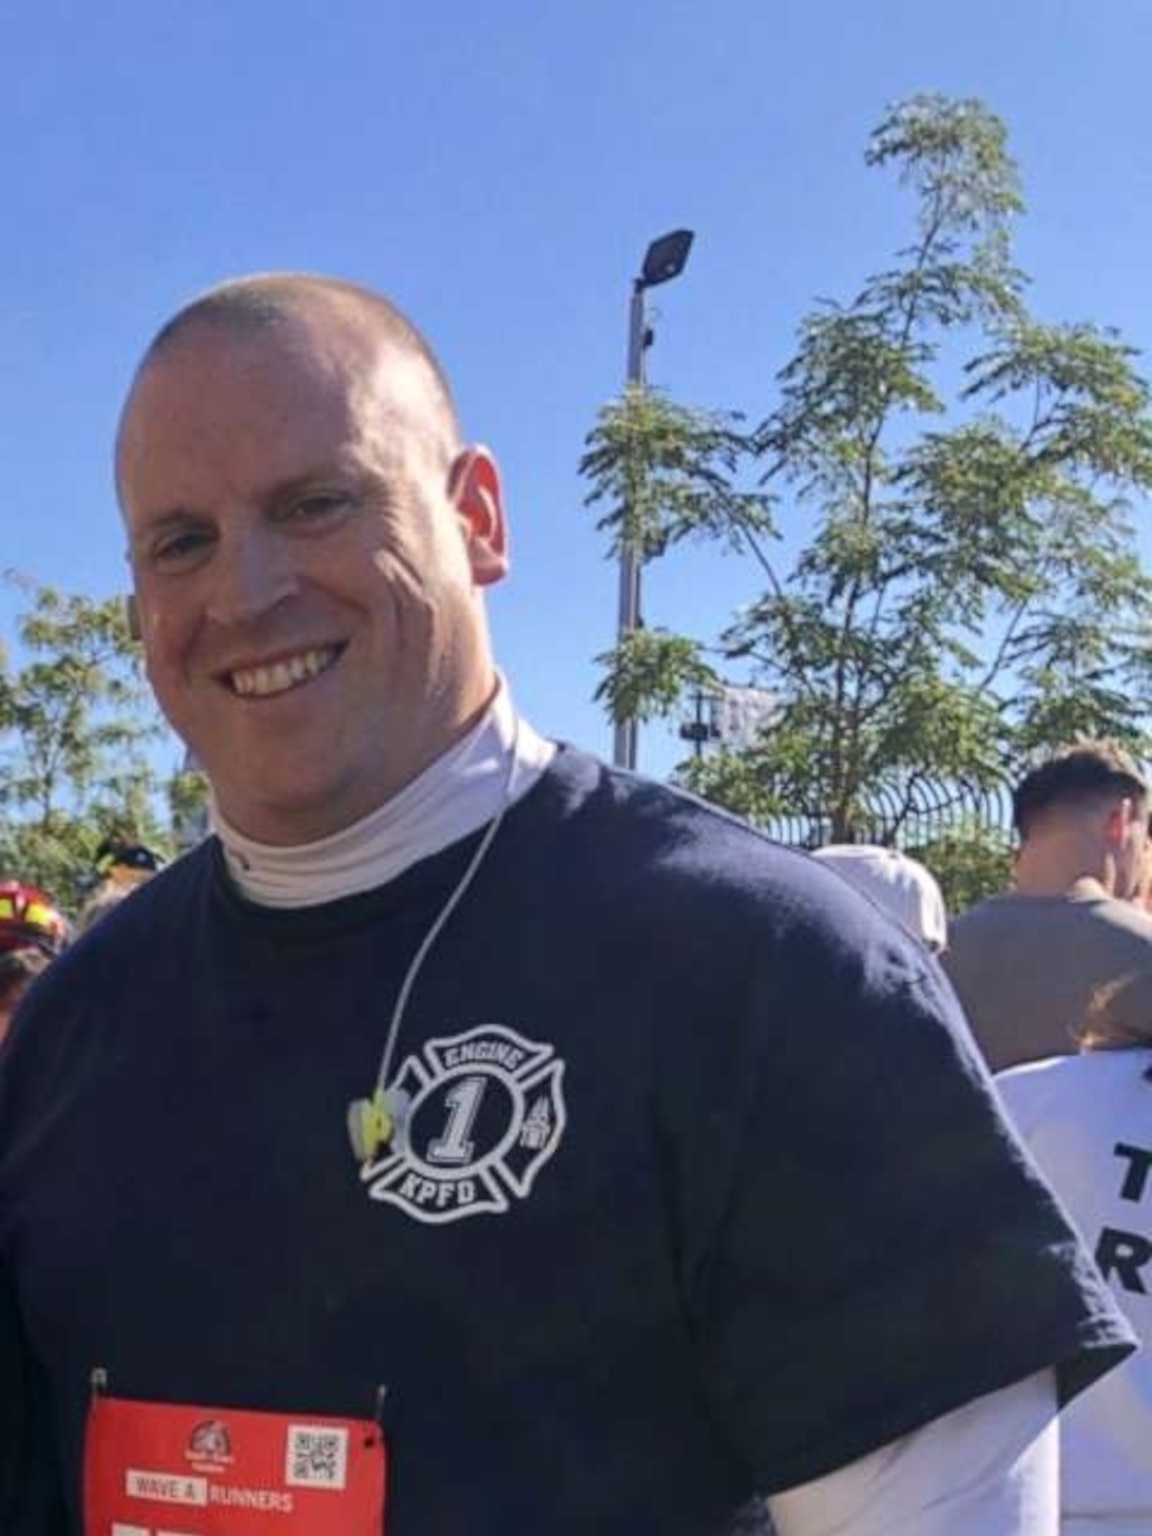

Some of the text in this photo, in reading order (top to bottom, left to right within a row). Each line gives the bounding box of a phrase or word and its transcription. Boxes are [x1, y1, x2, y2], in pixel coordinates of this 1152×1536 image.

[443, 1039, 525, 1070] ENGINE
[425, 1076, 488, 1164] 1
[399, 1172, 477, 1207] KPFD
[135, 1475, 294, 1514] WAVE A RUNNERS
